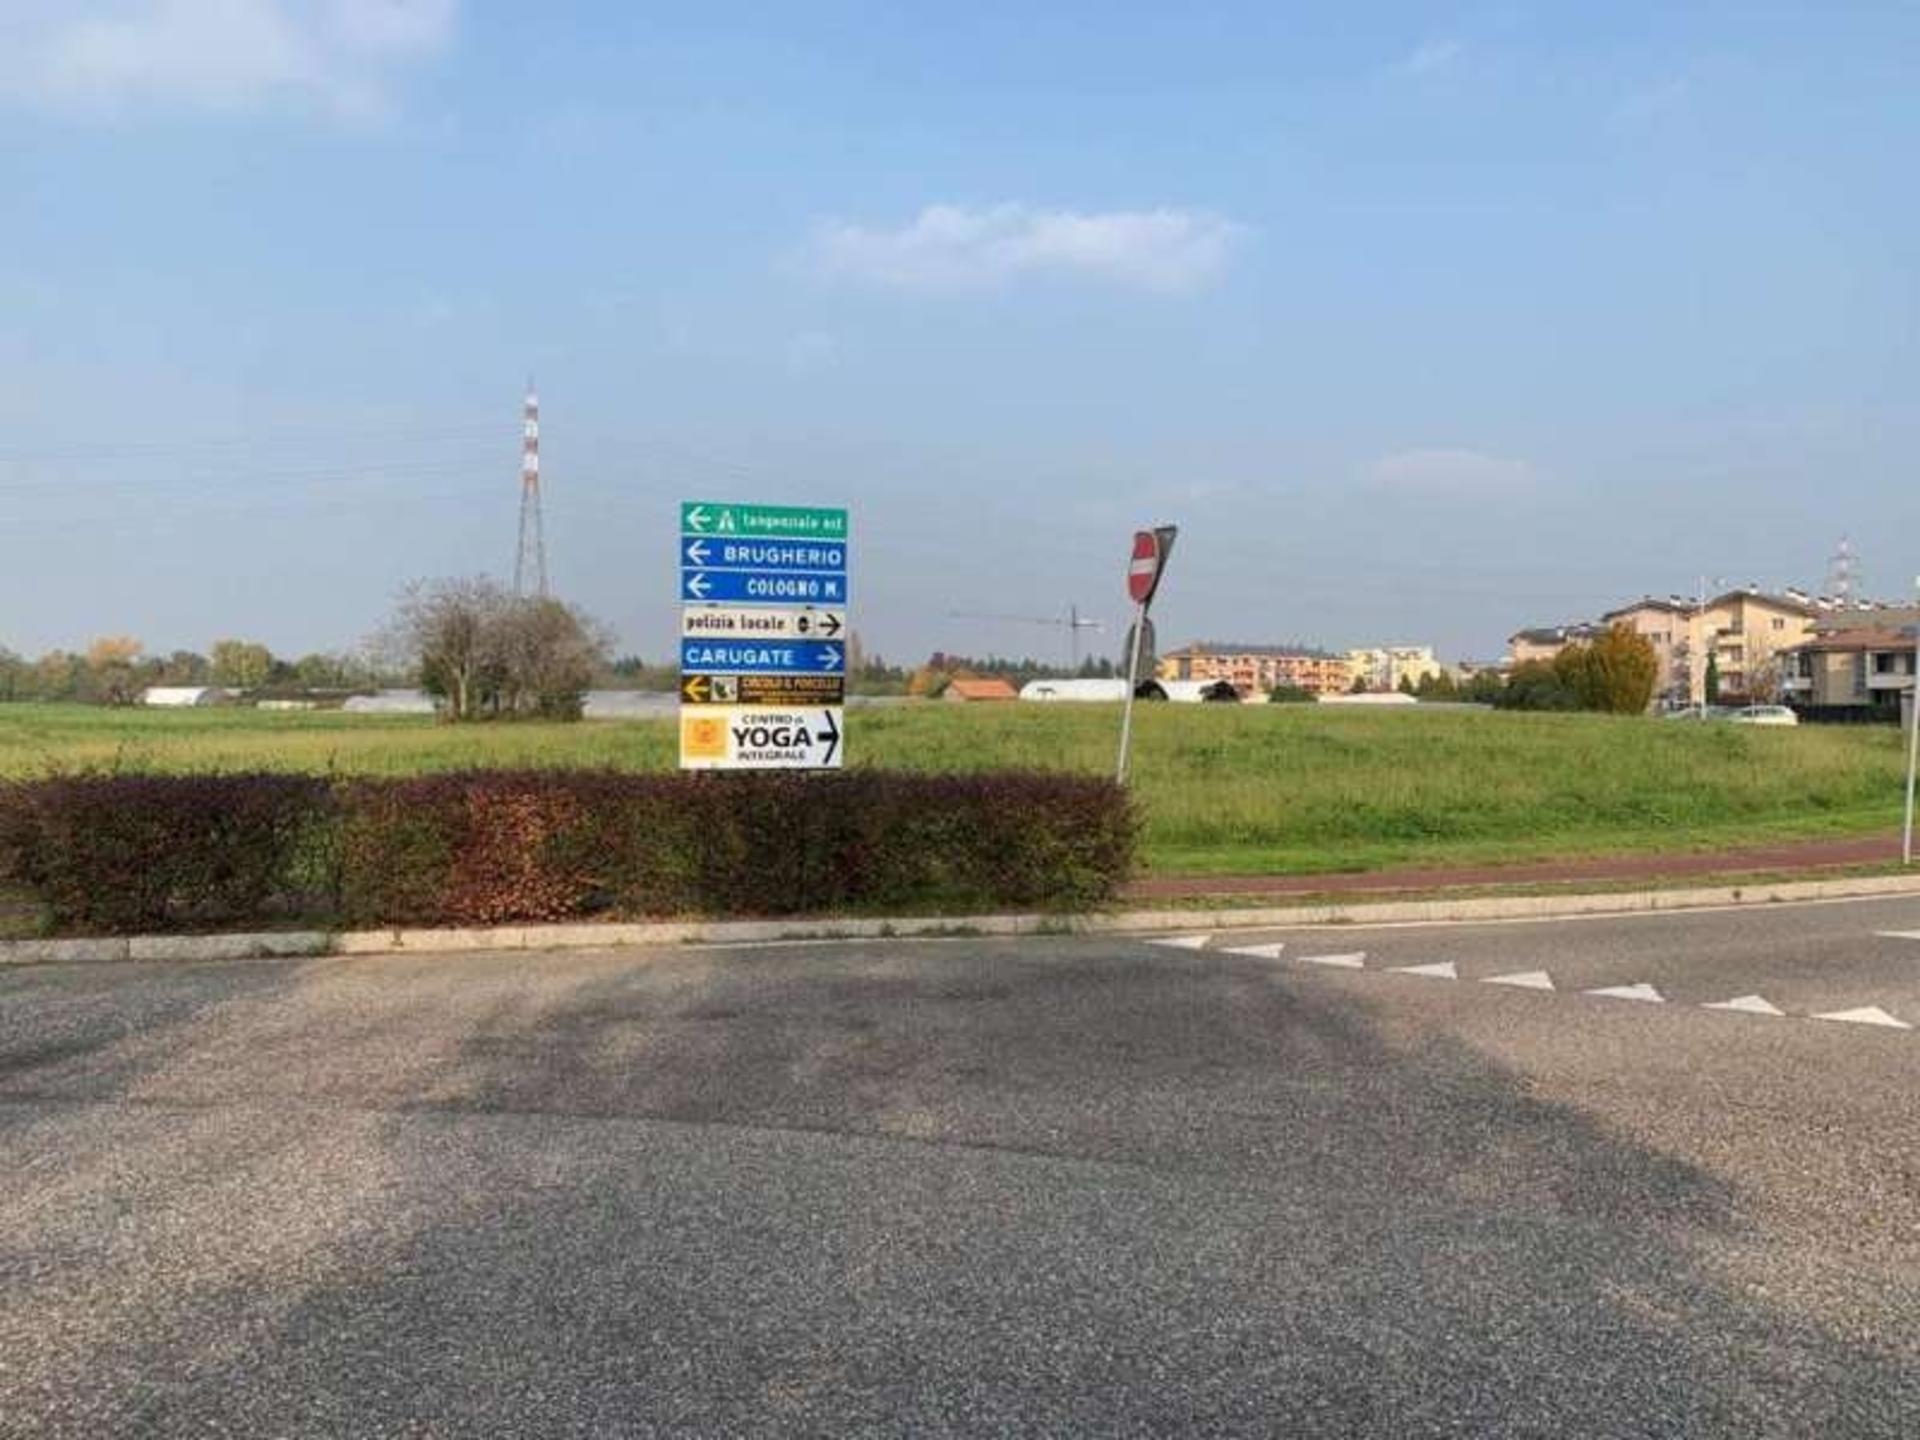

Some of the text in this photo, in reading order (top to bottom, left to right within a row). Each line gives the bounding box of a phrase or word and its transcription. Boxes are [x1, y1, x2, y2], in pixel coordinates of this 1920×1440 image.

[724, 546, 842, 566] BRUGHERIO
[747, 578, 819, 596] COLOGNO
[687, 615, 785, 630] polizia locale
[685, 647, 795, 665] CARUGATE
[742, 714, 792, 724] CENTRO
[732, 727, 812, 747] YOGA
[737, 751, 805, 760] INTEGRALE
